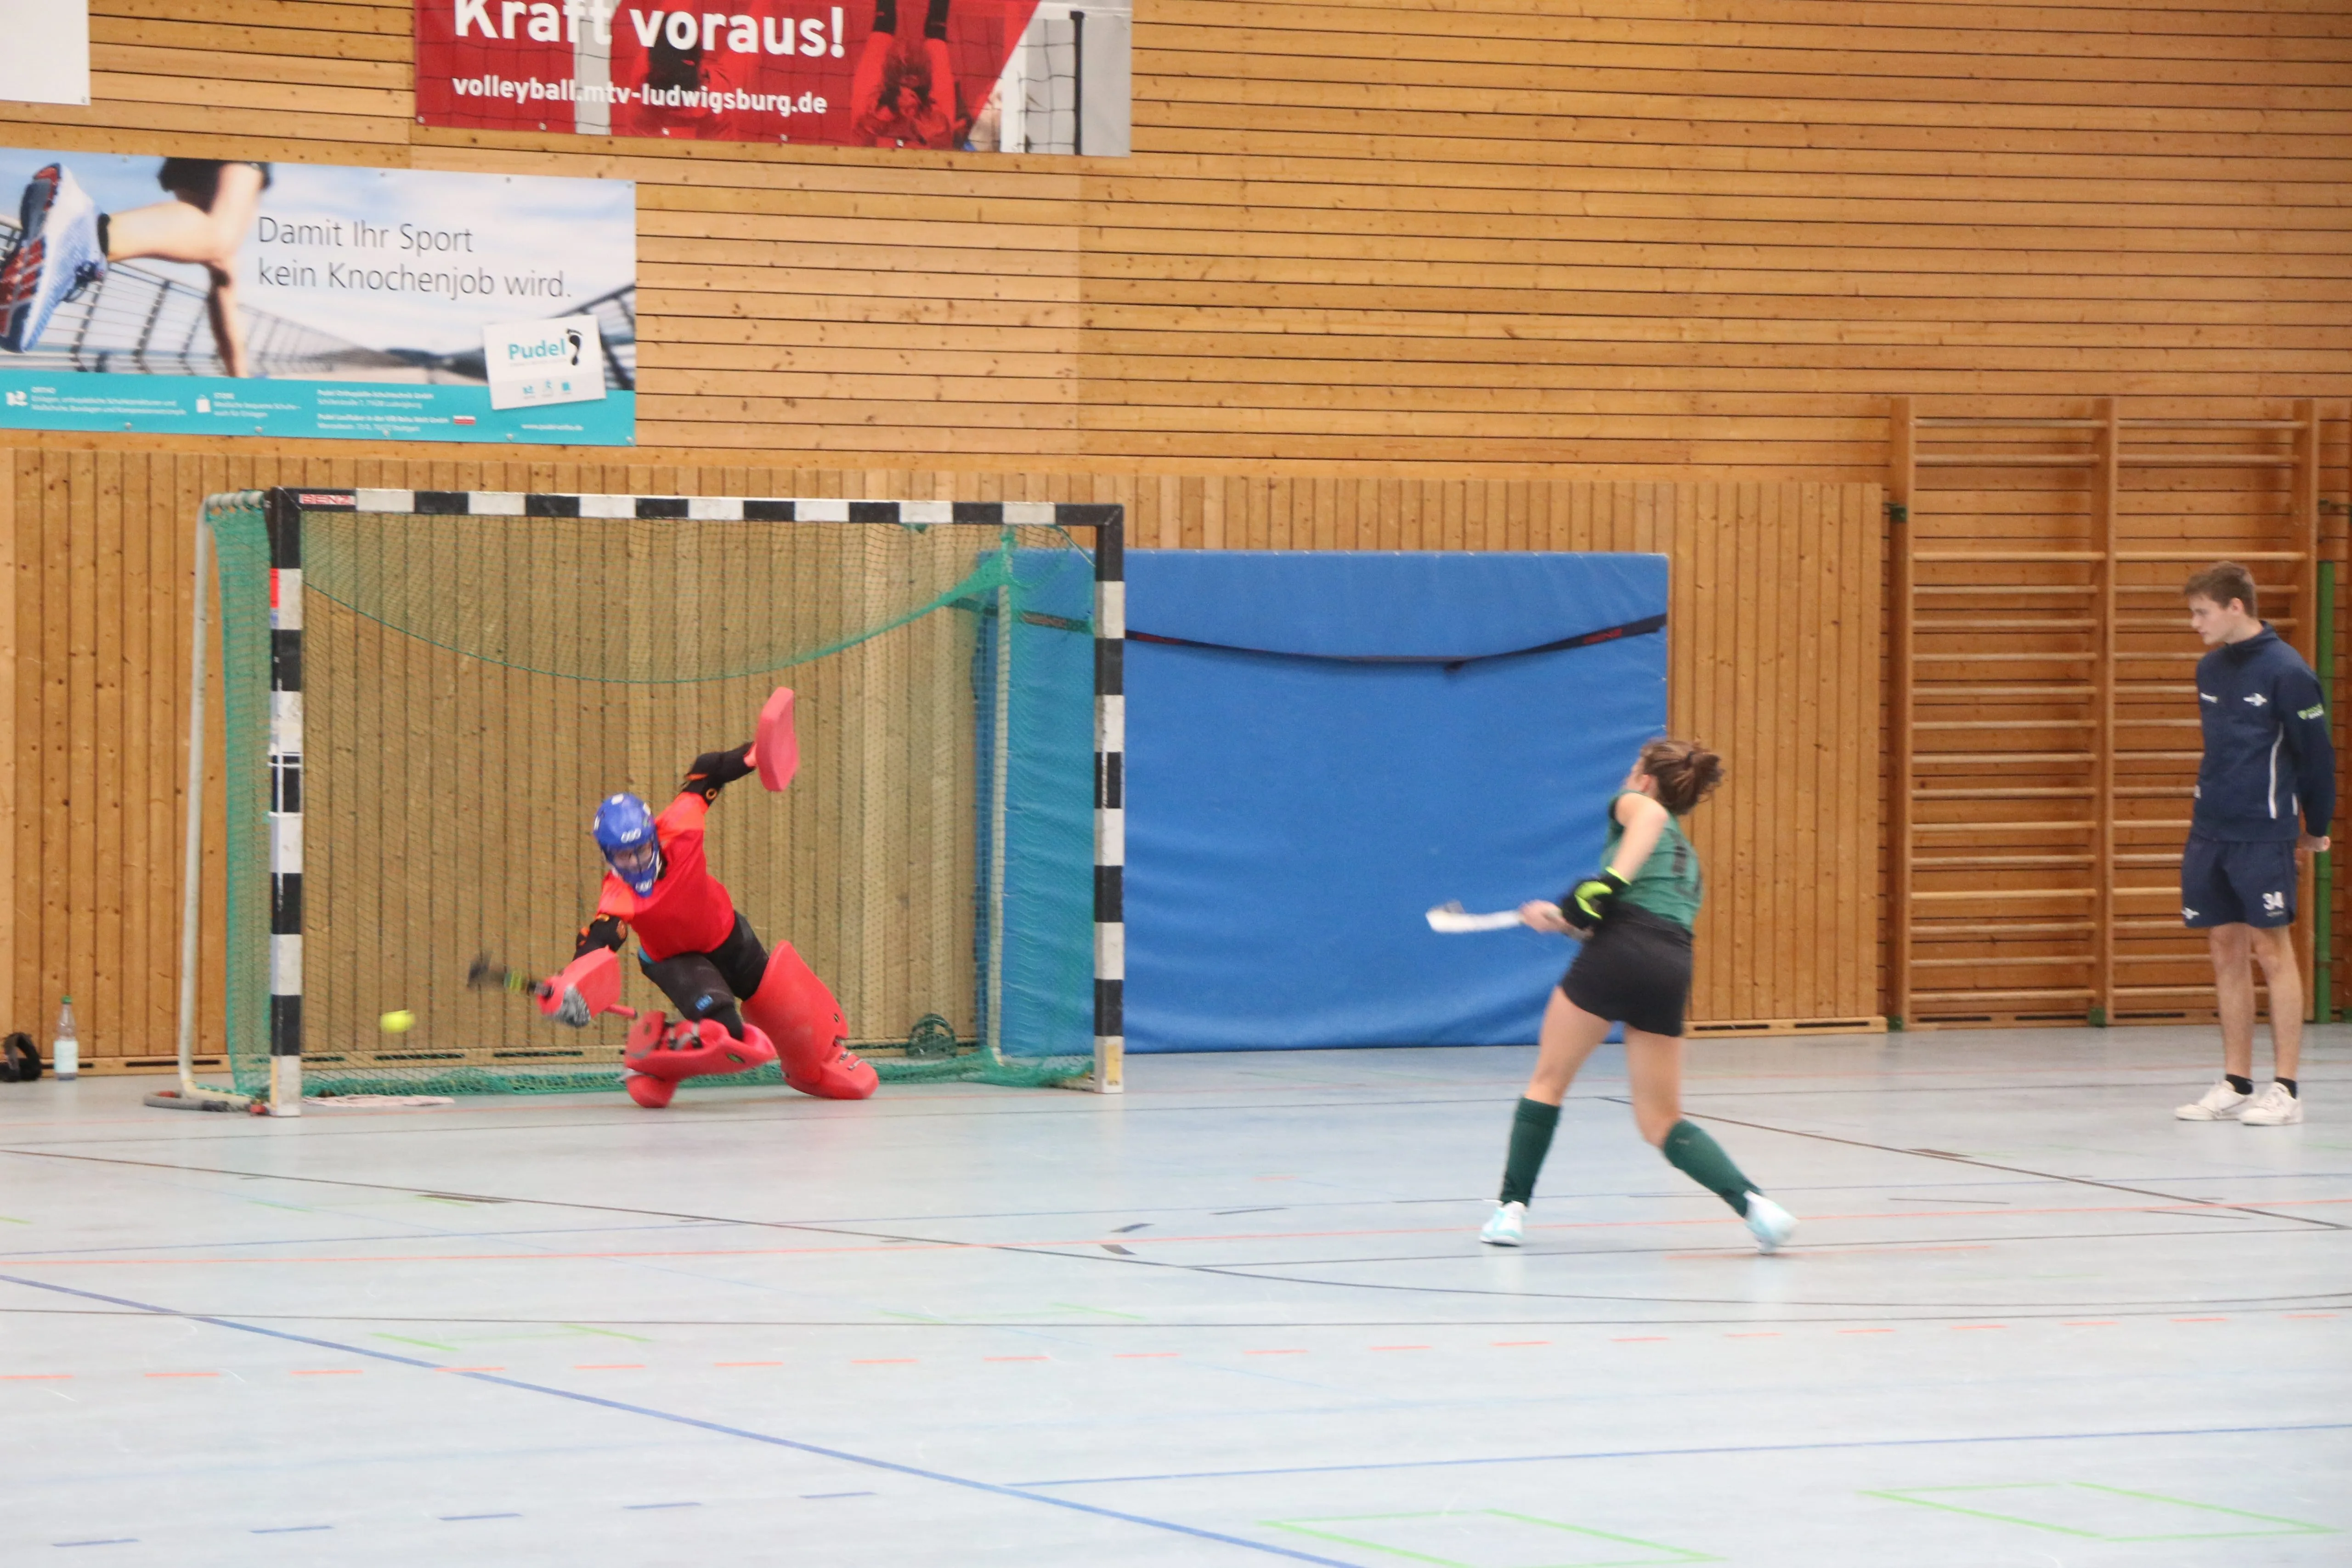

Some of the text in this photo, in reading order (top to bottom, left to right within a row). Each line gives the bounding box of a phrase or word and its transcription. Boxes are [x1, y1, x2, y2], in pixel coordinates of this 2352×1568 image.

[454, 0, 845, 58] Kraft voraus!
[452, 74, 828, 117] volleyball.mtv-ludwigsburg.de
[259, 216, 474, 257] Damit Ihr Sport
[259, 256, 571, 300] kein Knochenjob wird.
[508, 338, 567, 360] Pudel
[2262, 891, 2284, 911] 34
